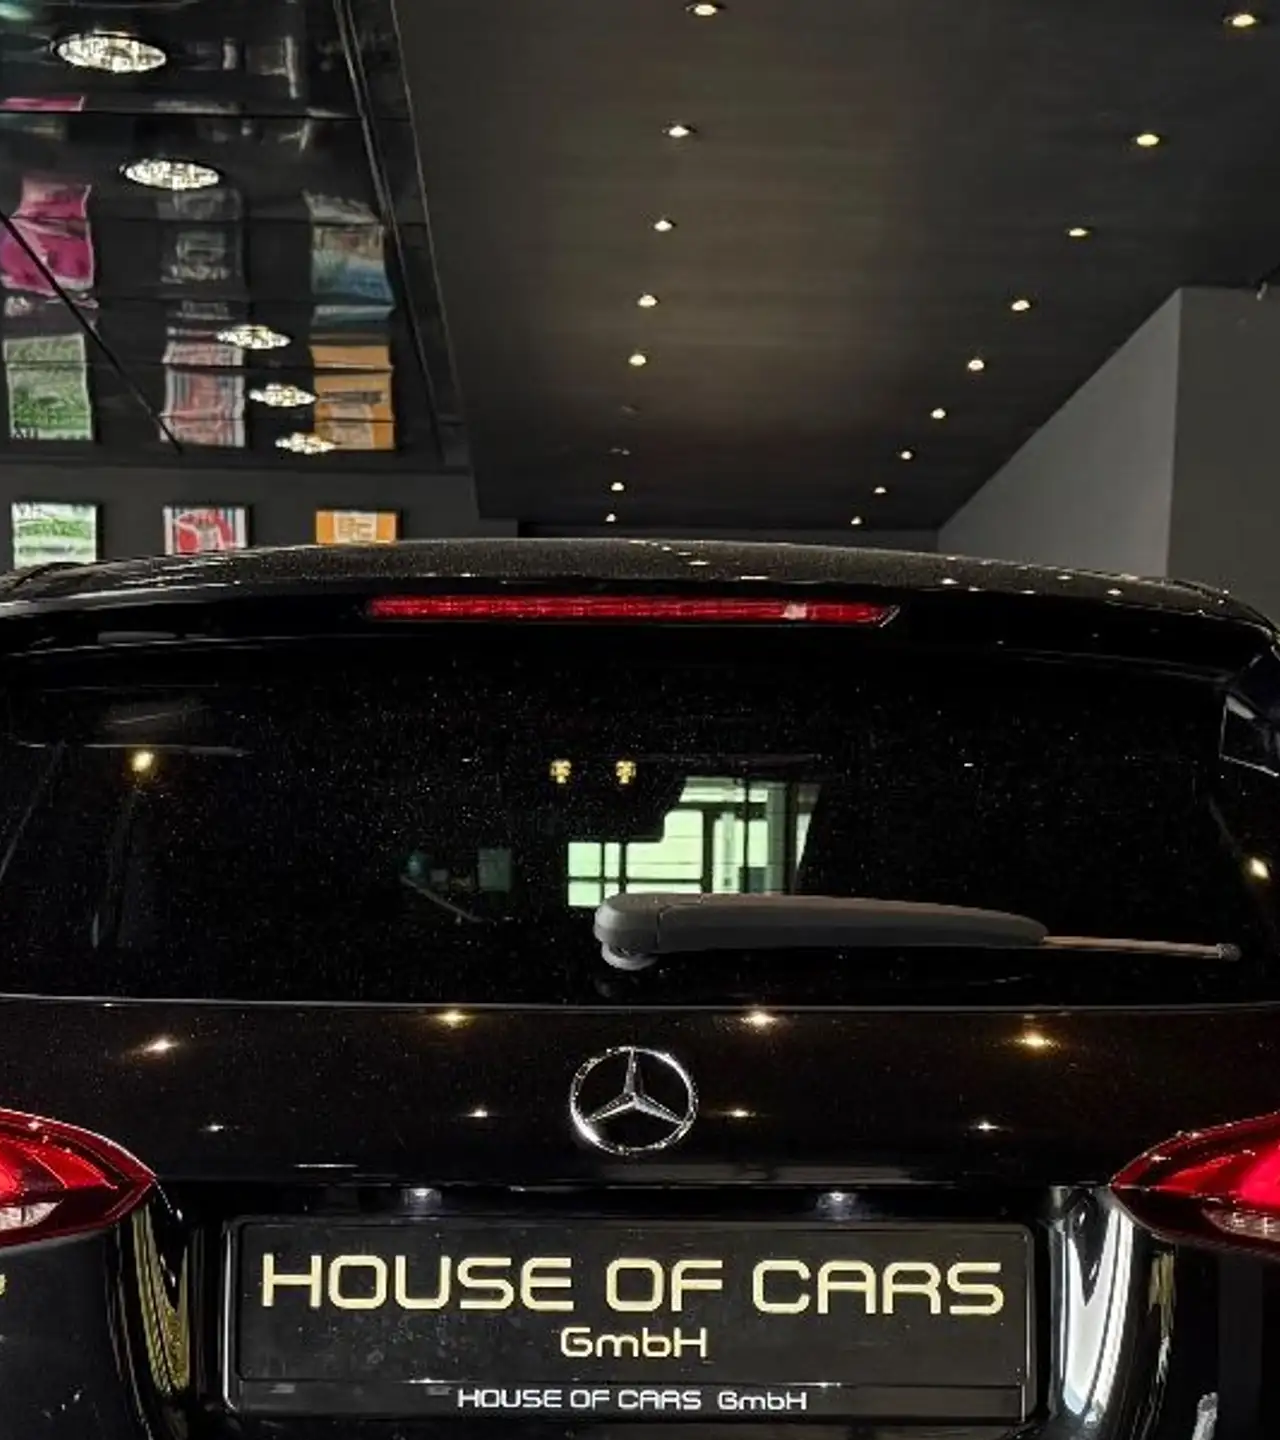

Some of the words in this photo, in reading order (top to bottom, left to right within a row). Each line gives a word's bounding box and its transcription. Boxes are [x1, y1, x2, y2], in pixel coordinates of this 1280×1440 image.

[261, 1252, 574, 1311] HOUSE
[605, 1256, 724, 1313] OF
[752, 1259, 1005, 1315] CARS
[560, 1326, 708, 1358] GmbH
[456, 1388, 562, 1409] HOUSE
[569, 1389, 610, 1411] OF
[617, 1389, 702, 1411] CARS
[716, 1390, 808, 1411] GmbH
